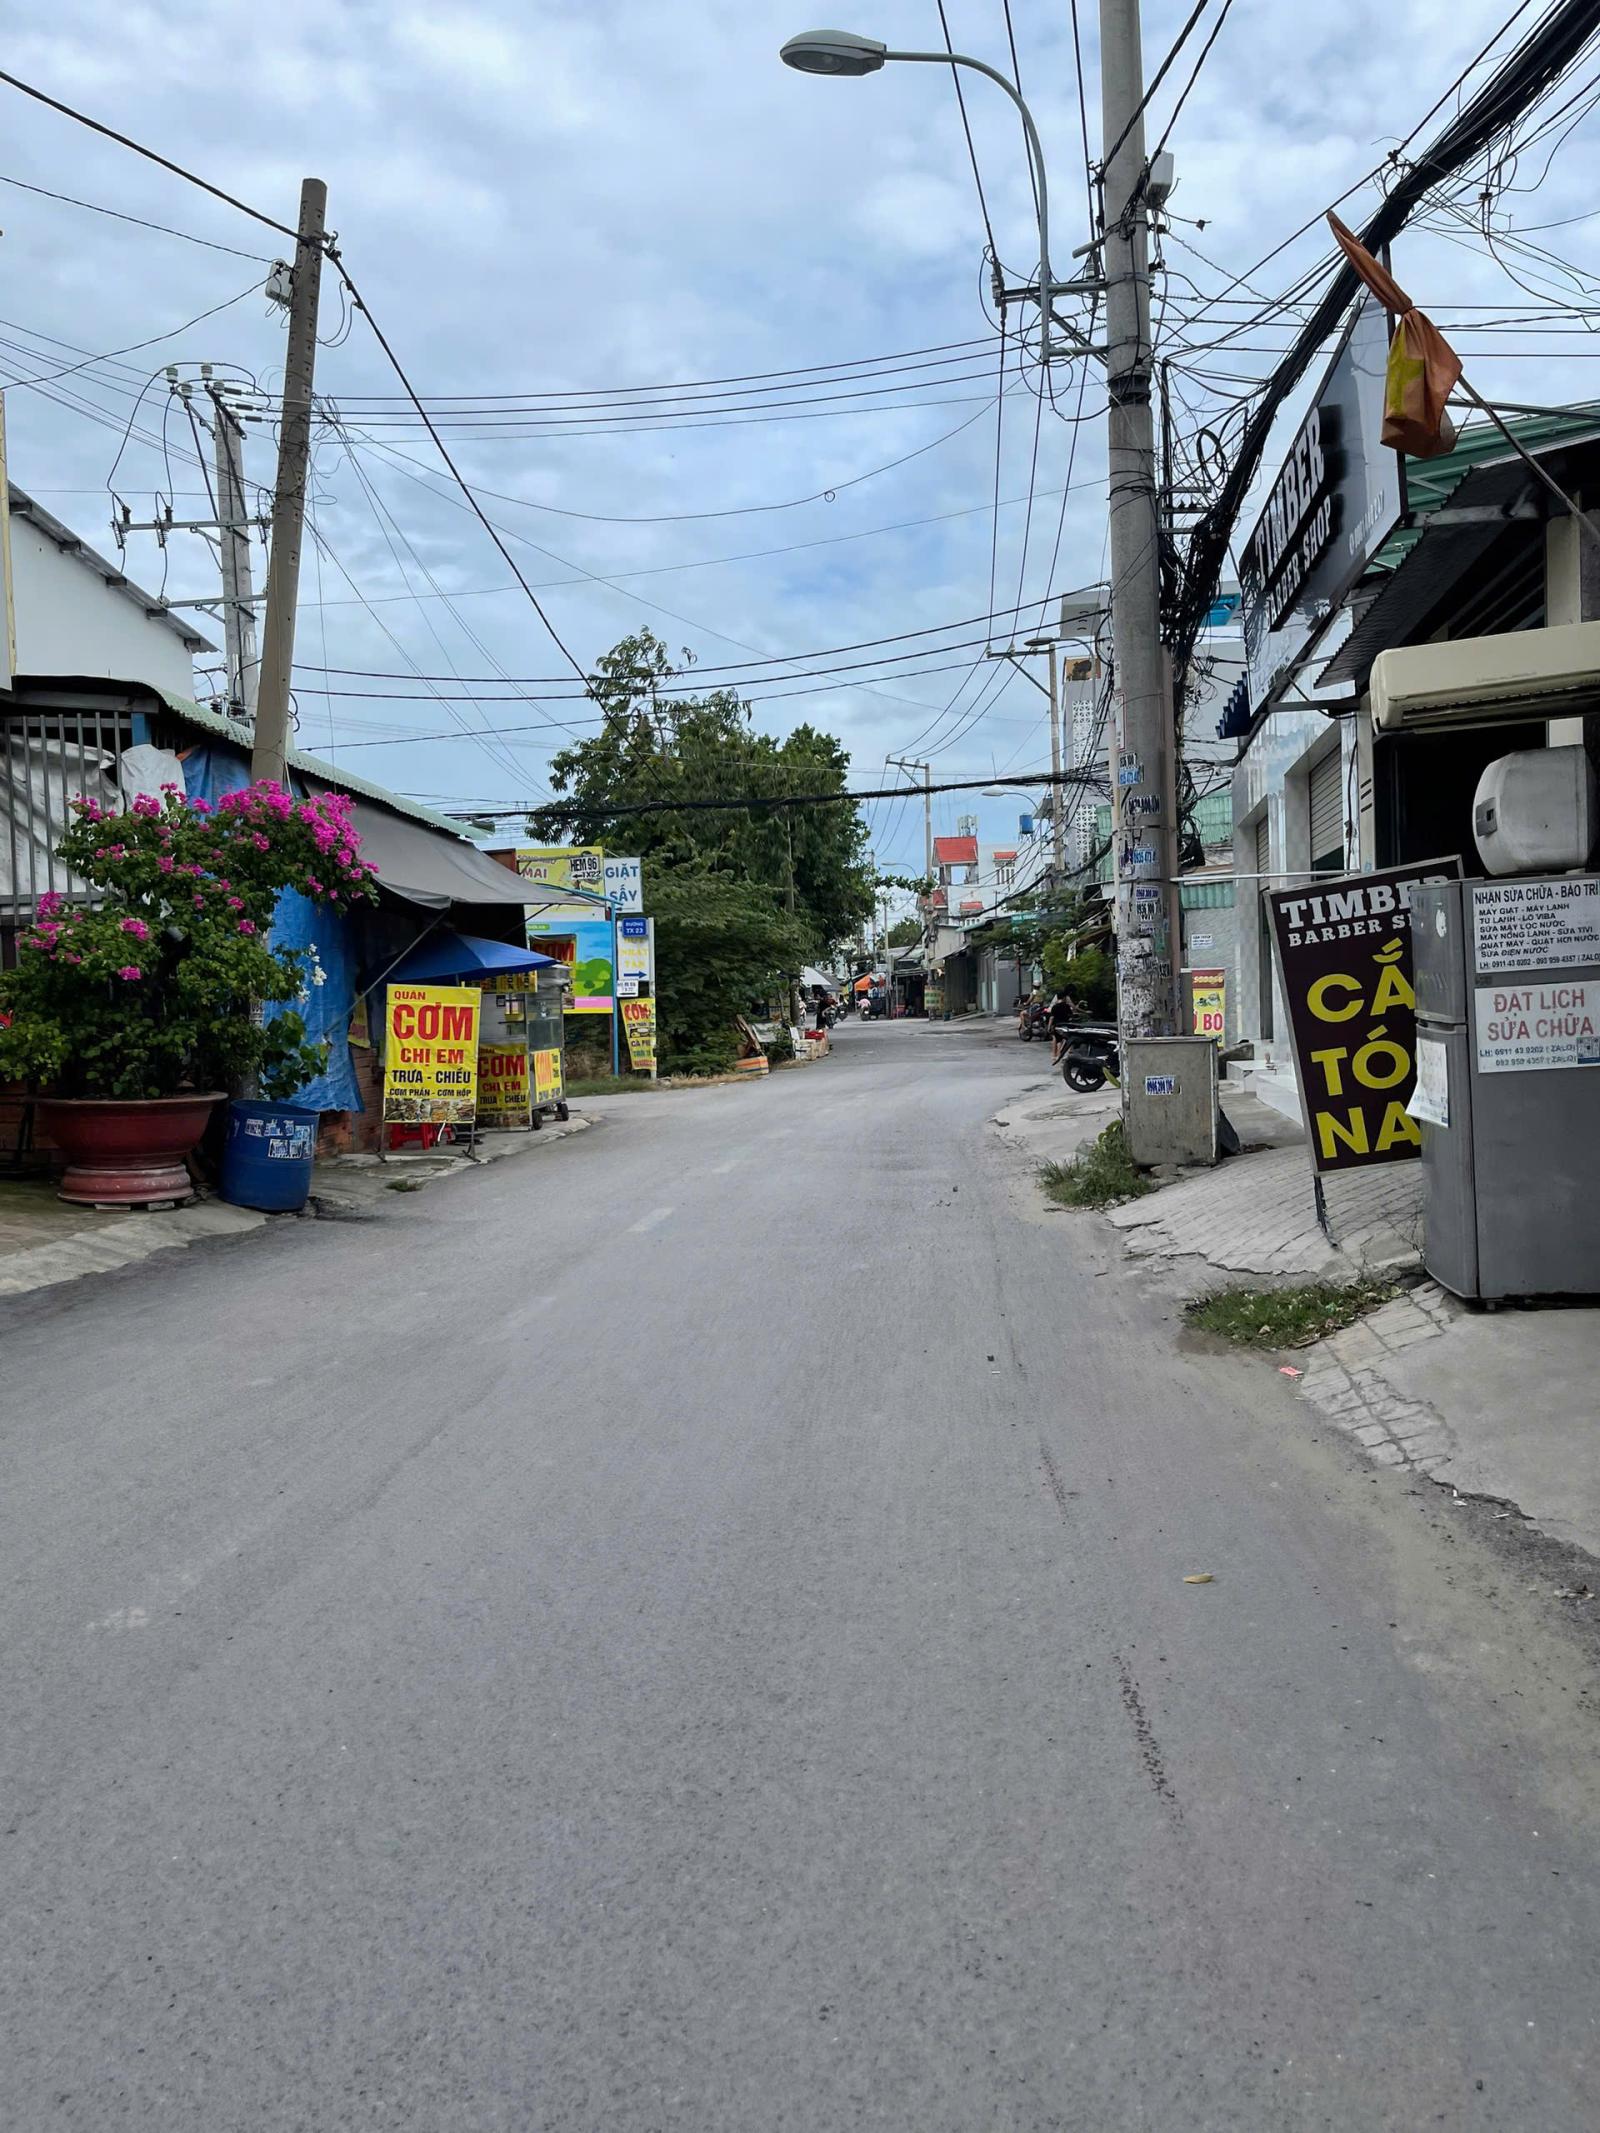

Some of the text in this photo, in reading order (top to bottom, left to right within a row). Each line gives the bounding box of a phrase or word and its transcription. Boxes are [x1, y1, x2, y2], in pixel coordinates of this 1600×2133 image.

[1254, 406, 1325, 590] TIMBER
[1303, 494, 1332, 571] SHOP
[587, 857, 598, 870] 96
[605, 863, 639, 880] GIẶT
[609, 884, 637, 902] SẤY
[1503, 886, 1524, 903] SỬA
[1525, 884, 1554, 901] CHỮA
[1560, 883, 1581, 898] BẢO
[1287, 919, 1382, 947] BARBER
[1493, 988, 1585, 1016] ĐẠT LỊCH
[393, 1002, 473, 1041] CƠM
[1487, 1012, 1594, 1042] SỬA CHỮA
[400, 1047, 465, 1067] CHỊ EM
[391, 1069, 424, 1084] TRƯA
[504, 1080, 521, 1092] EM
[389, 1088, 408, 1096] CƠM
[437, 1088, 455, 1097] CƠM
